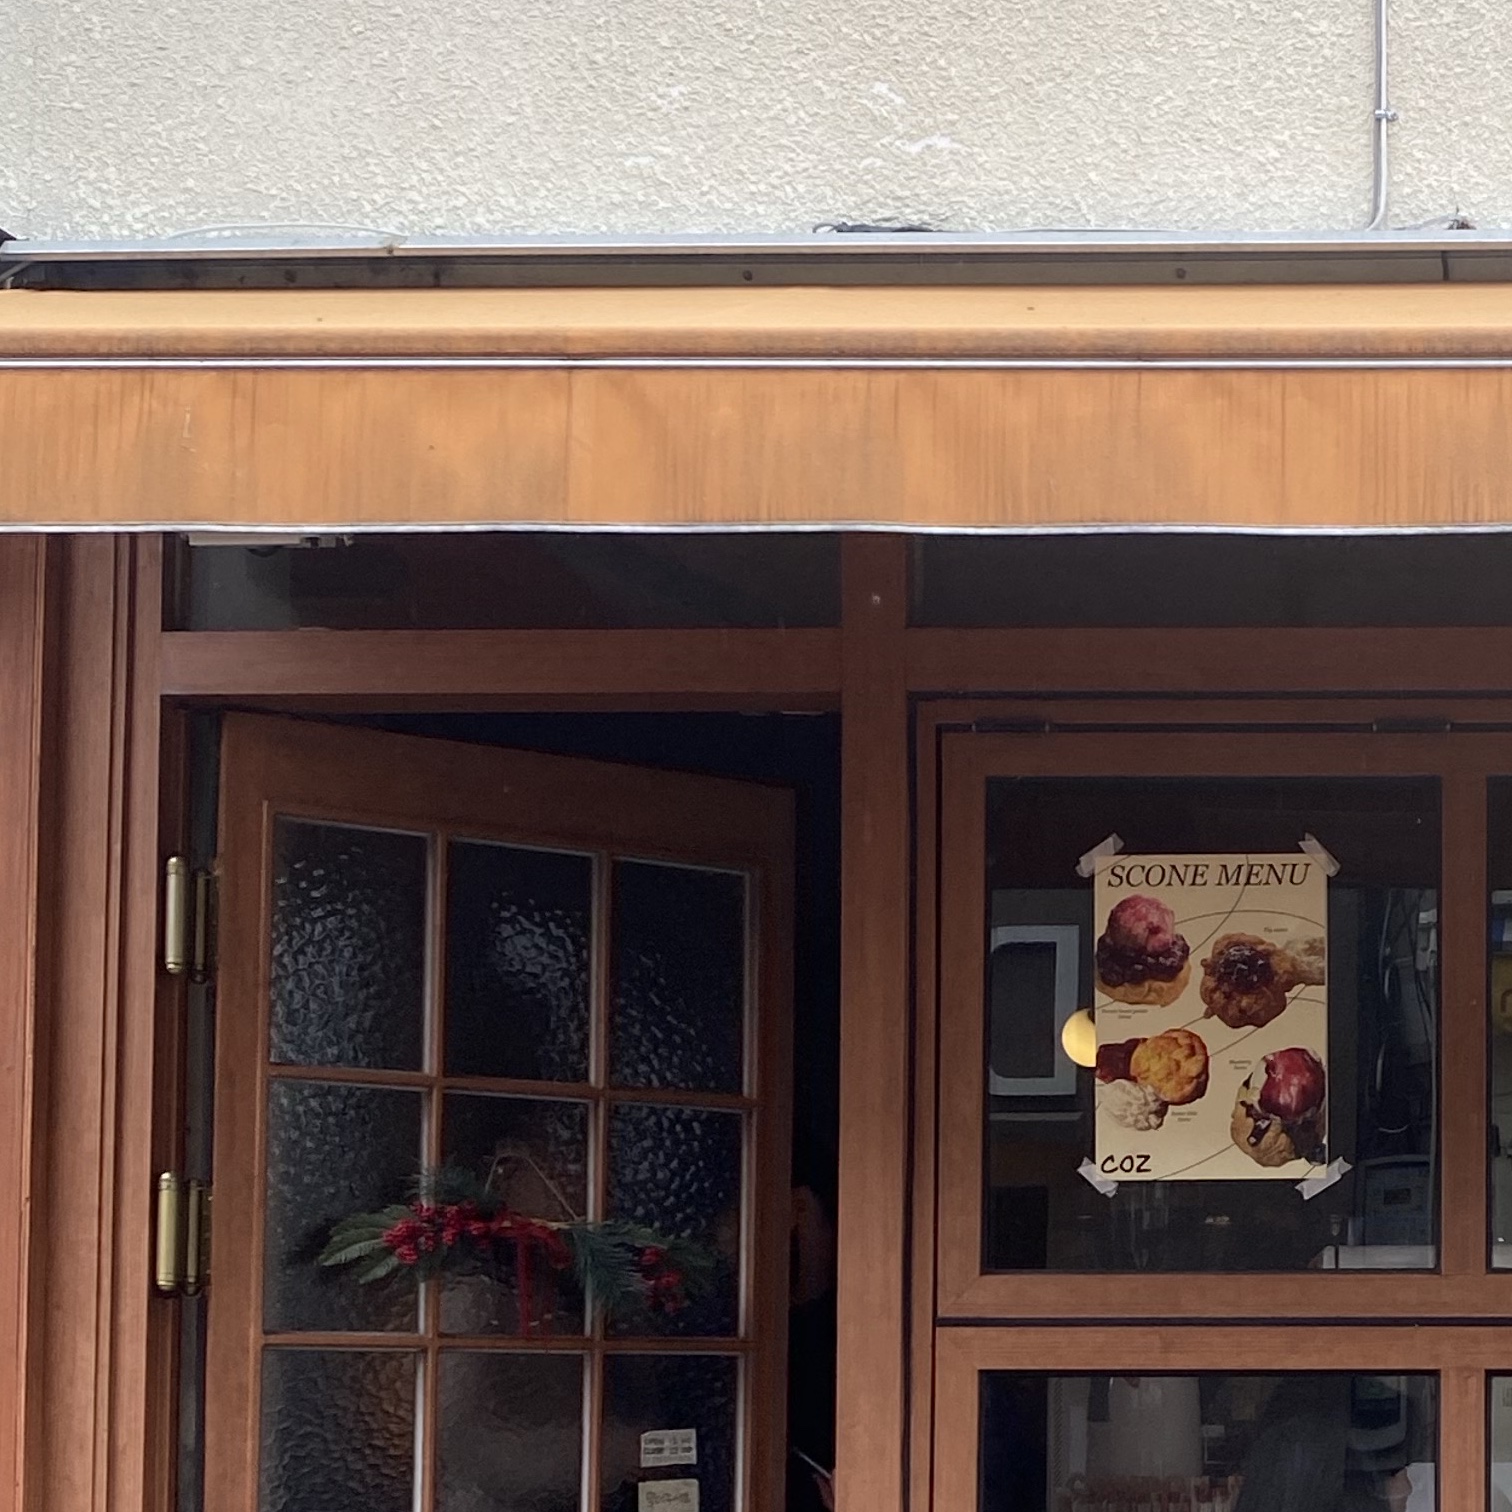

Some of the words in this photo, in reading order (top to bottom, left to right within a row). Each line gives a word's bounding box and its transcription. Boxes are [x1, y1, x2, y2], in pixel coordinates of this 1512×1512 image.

[1107, 863, 1208, 888] SCONE
[1214, 862, 1310, 887] MENU
[1100, 1154, 1152, 1175] COZ
